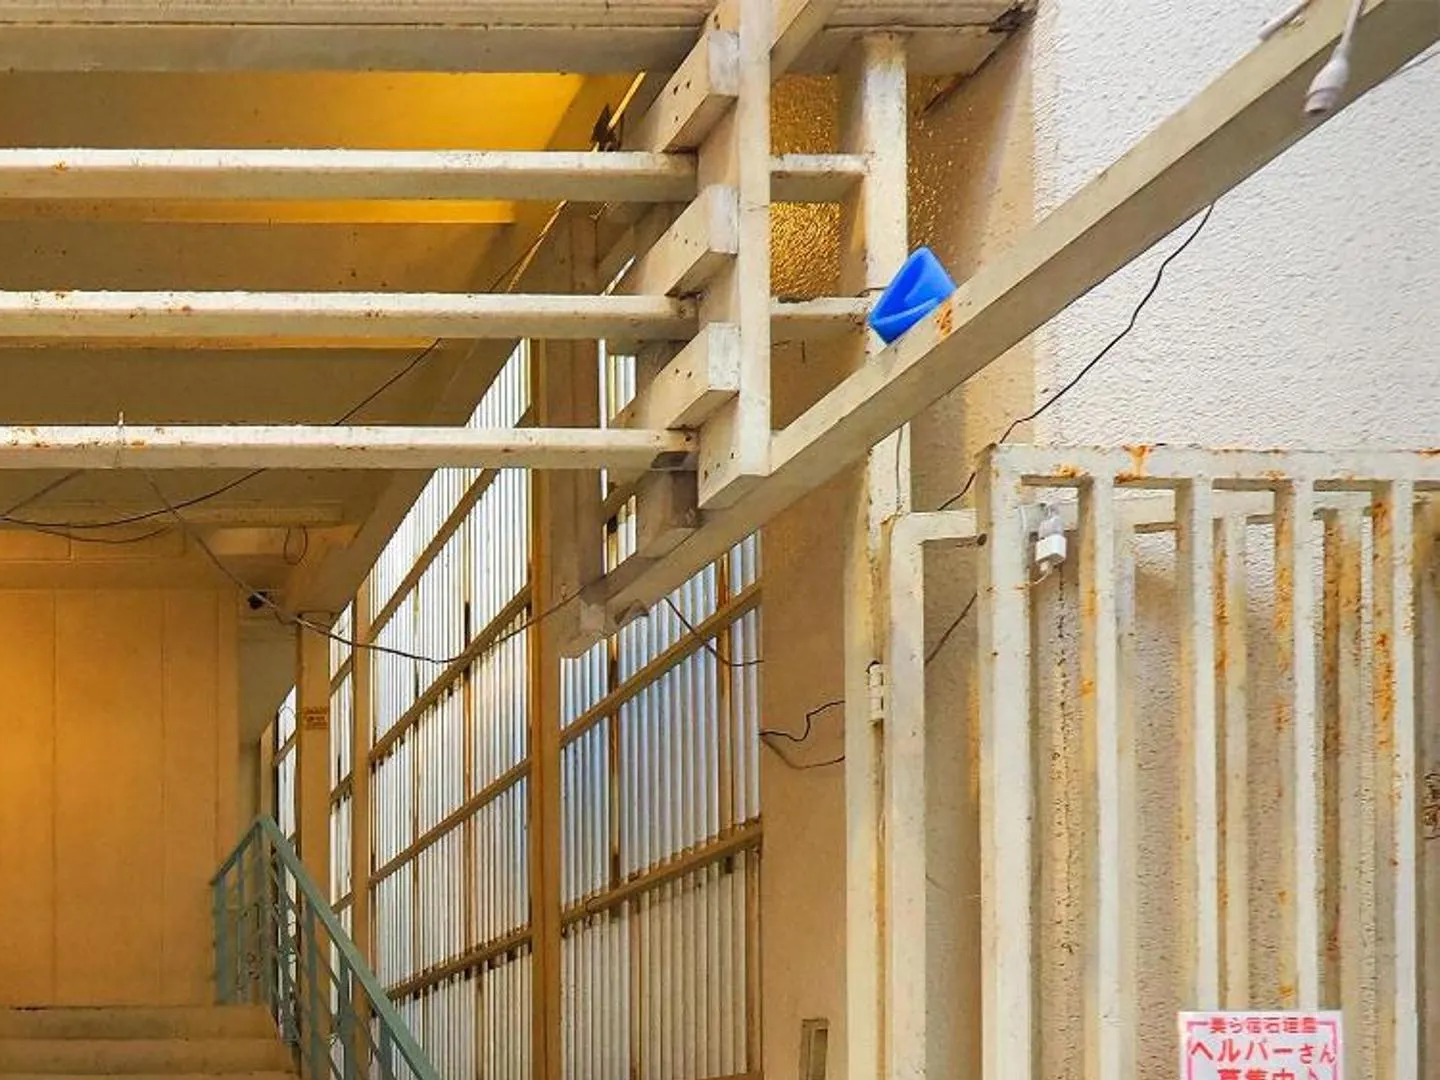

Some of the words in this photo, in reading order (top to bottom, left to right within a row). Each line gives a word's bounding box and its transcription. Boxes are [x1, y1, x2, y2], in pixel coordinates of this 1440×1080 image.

[1190, 1037, 1336, 1065] ヘルパーさん
